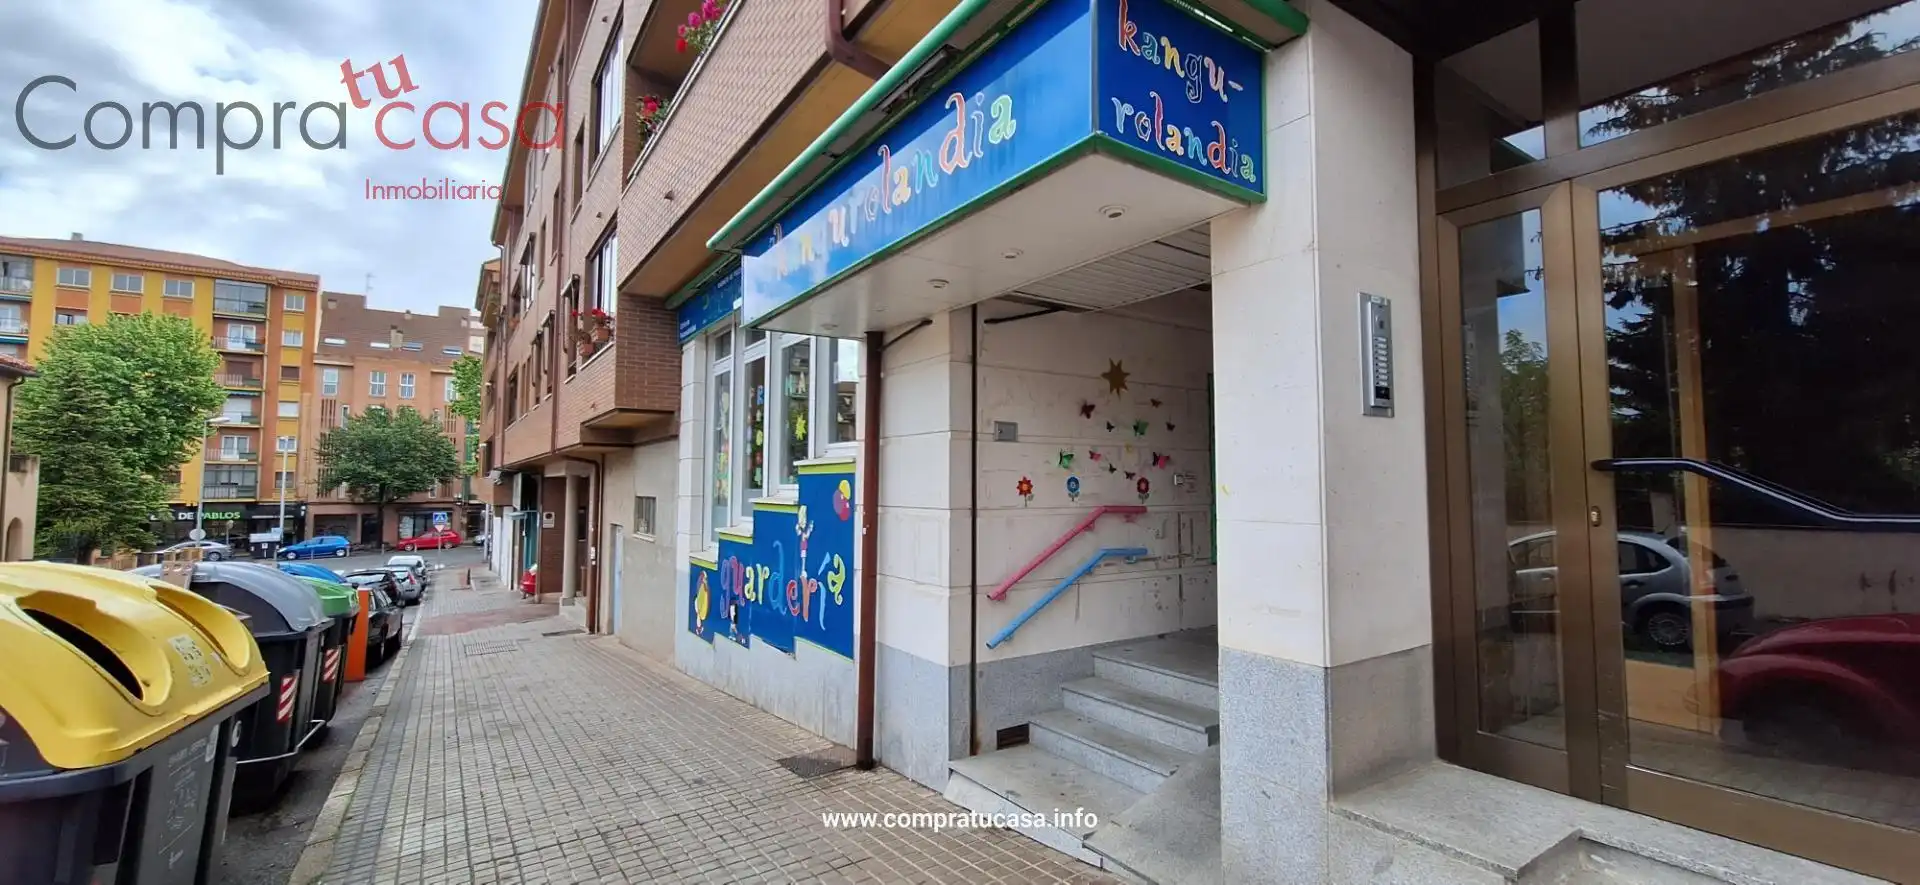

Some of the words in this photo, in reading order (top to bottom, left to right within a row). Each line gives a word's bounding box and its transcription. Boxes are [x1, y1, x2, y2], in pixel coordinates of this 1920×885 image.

[1118, 0, 1244, 103] kangu-
[1112, 91, 1256, 182] rolandia
[768, 92, 1017, 279] knurolandia
[178, 512, 194, 520] DE
[720, 540, 846, 631] guardería
